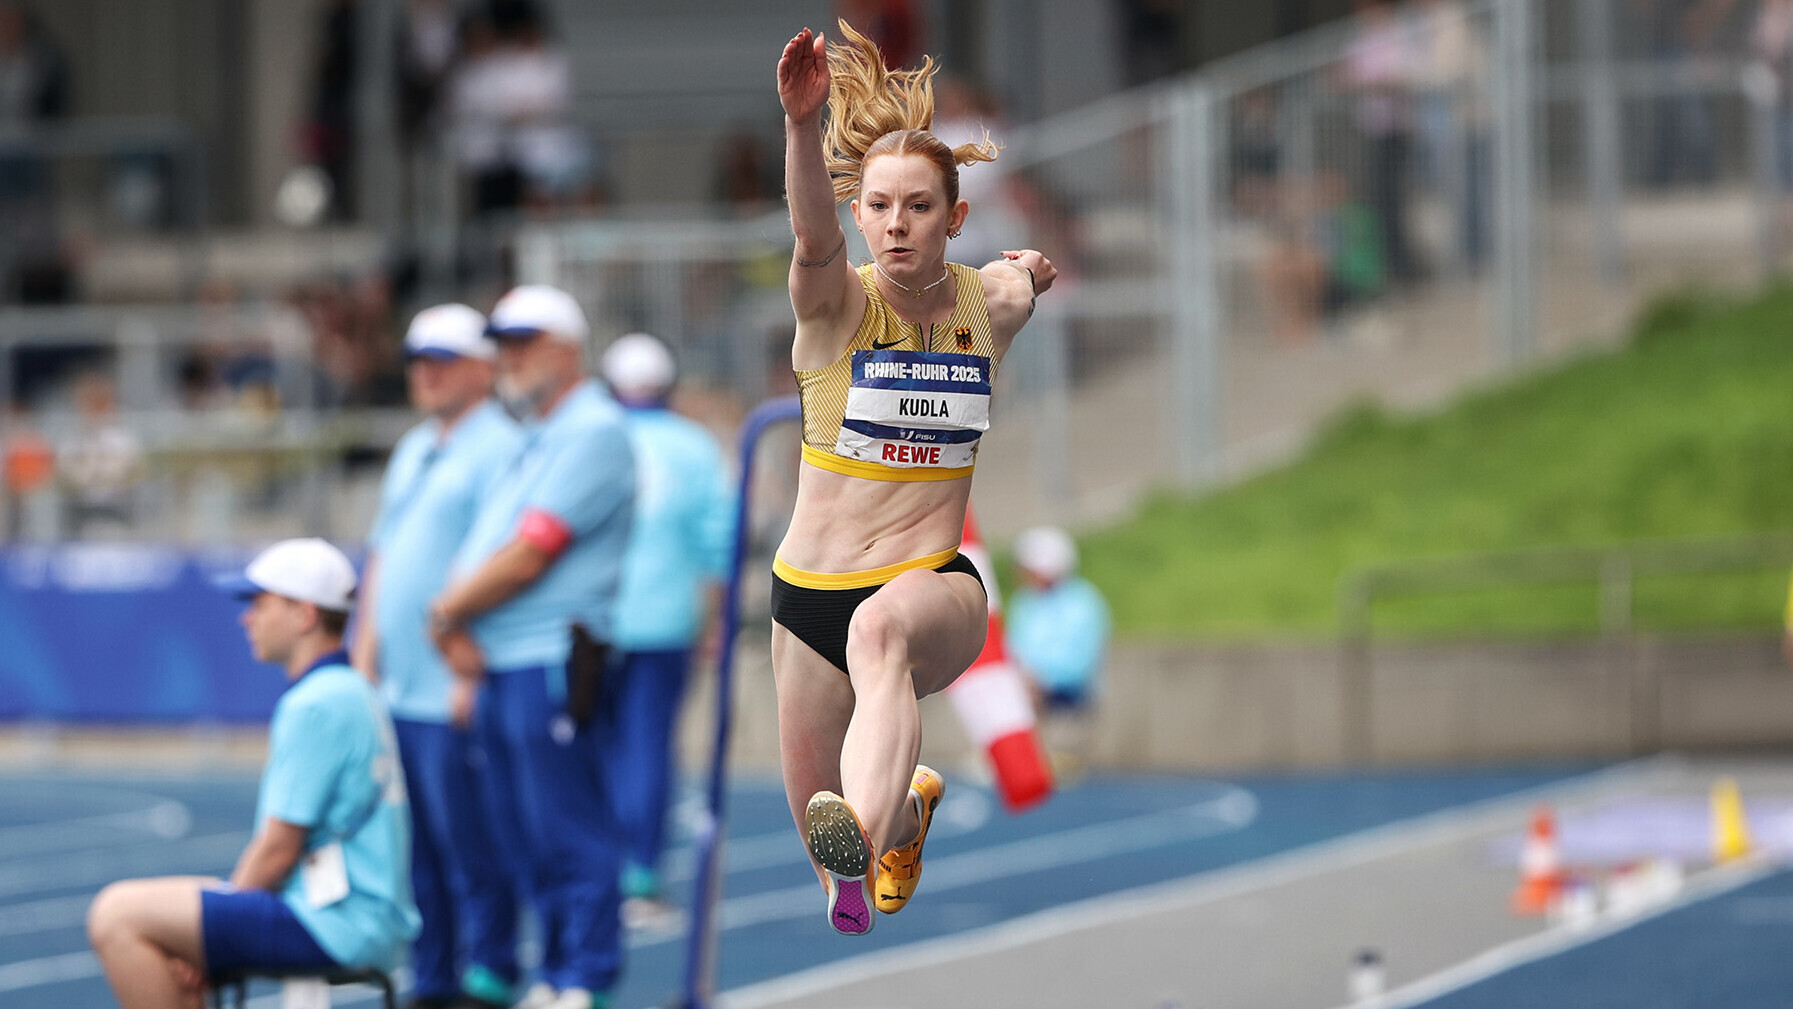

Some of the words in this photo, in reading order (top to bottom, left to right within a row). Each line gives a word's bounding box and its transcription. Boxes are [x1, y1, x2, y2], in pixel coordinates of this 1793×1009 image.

[864, 362, 949, 381] RHINE-RUHR
[951, 366, 981, 382] 2025
[899, 398, 949, 417] KUDLA
[882, 443, 941, 464] REWE
